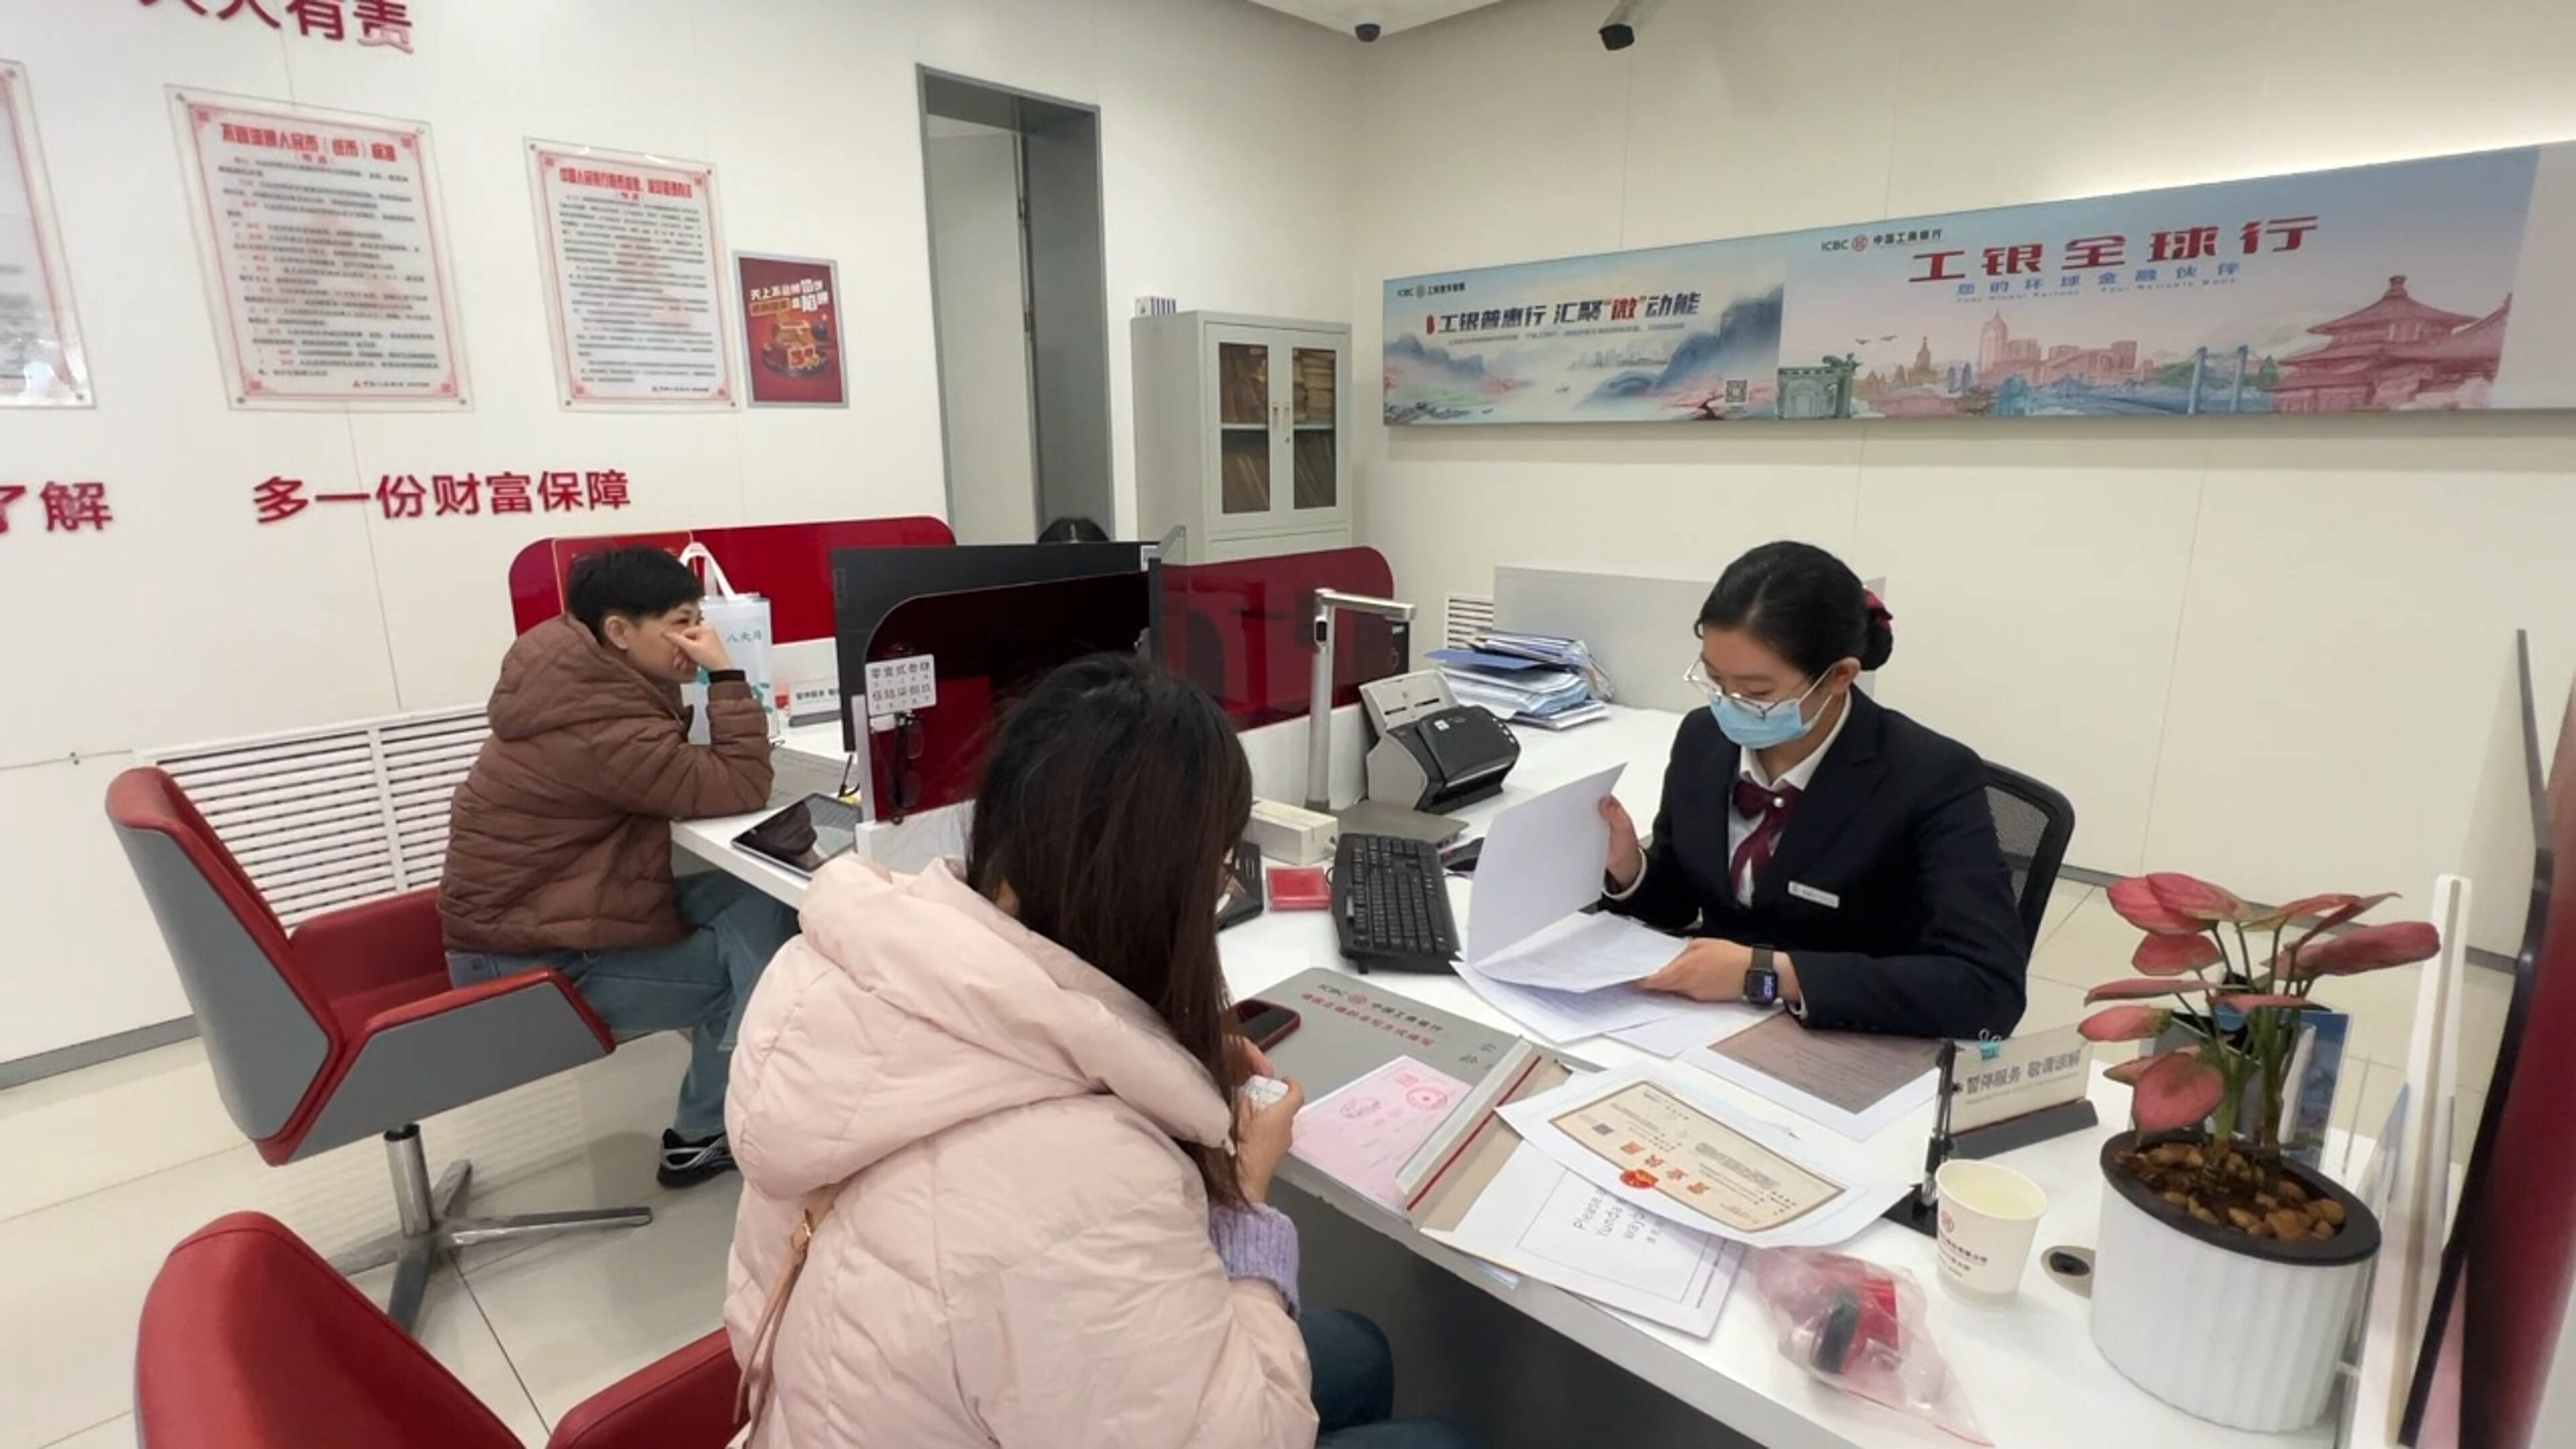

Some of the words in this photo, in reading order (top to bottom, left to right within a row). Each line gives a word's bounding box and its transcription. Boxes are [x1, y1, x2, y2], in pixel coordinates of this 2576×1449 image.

[1821, 239, 1849, 252] ICBC
[1874, 229, 1943, 246] 中国工商银行
[1909, 215, 2320, 282] 工银全球行
[1956, 262, 2241, 297] 您的环球金融伙伴
[1438, 305, 1547, 333] 工银普惠行
[253, 469, 631, 524] 多一份财富保障
[1966, 1066, 2021, 1095] 暂停服务
[1572, 1196, 1603, 1230] Please
